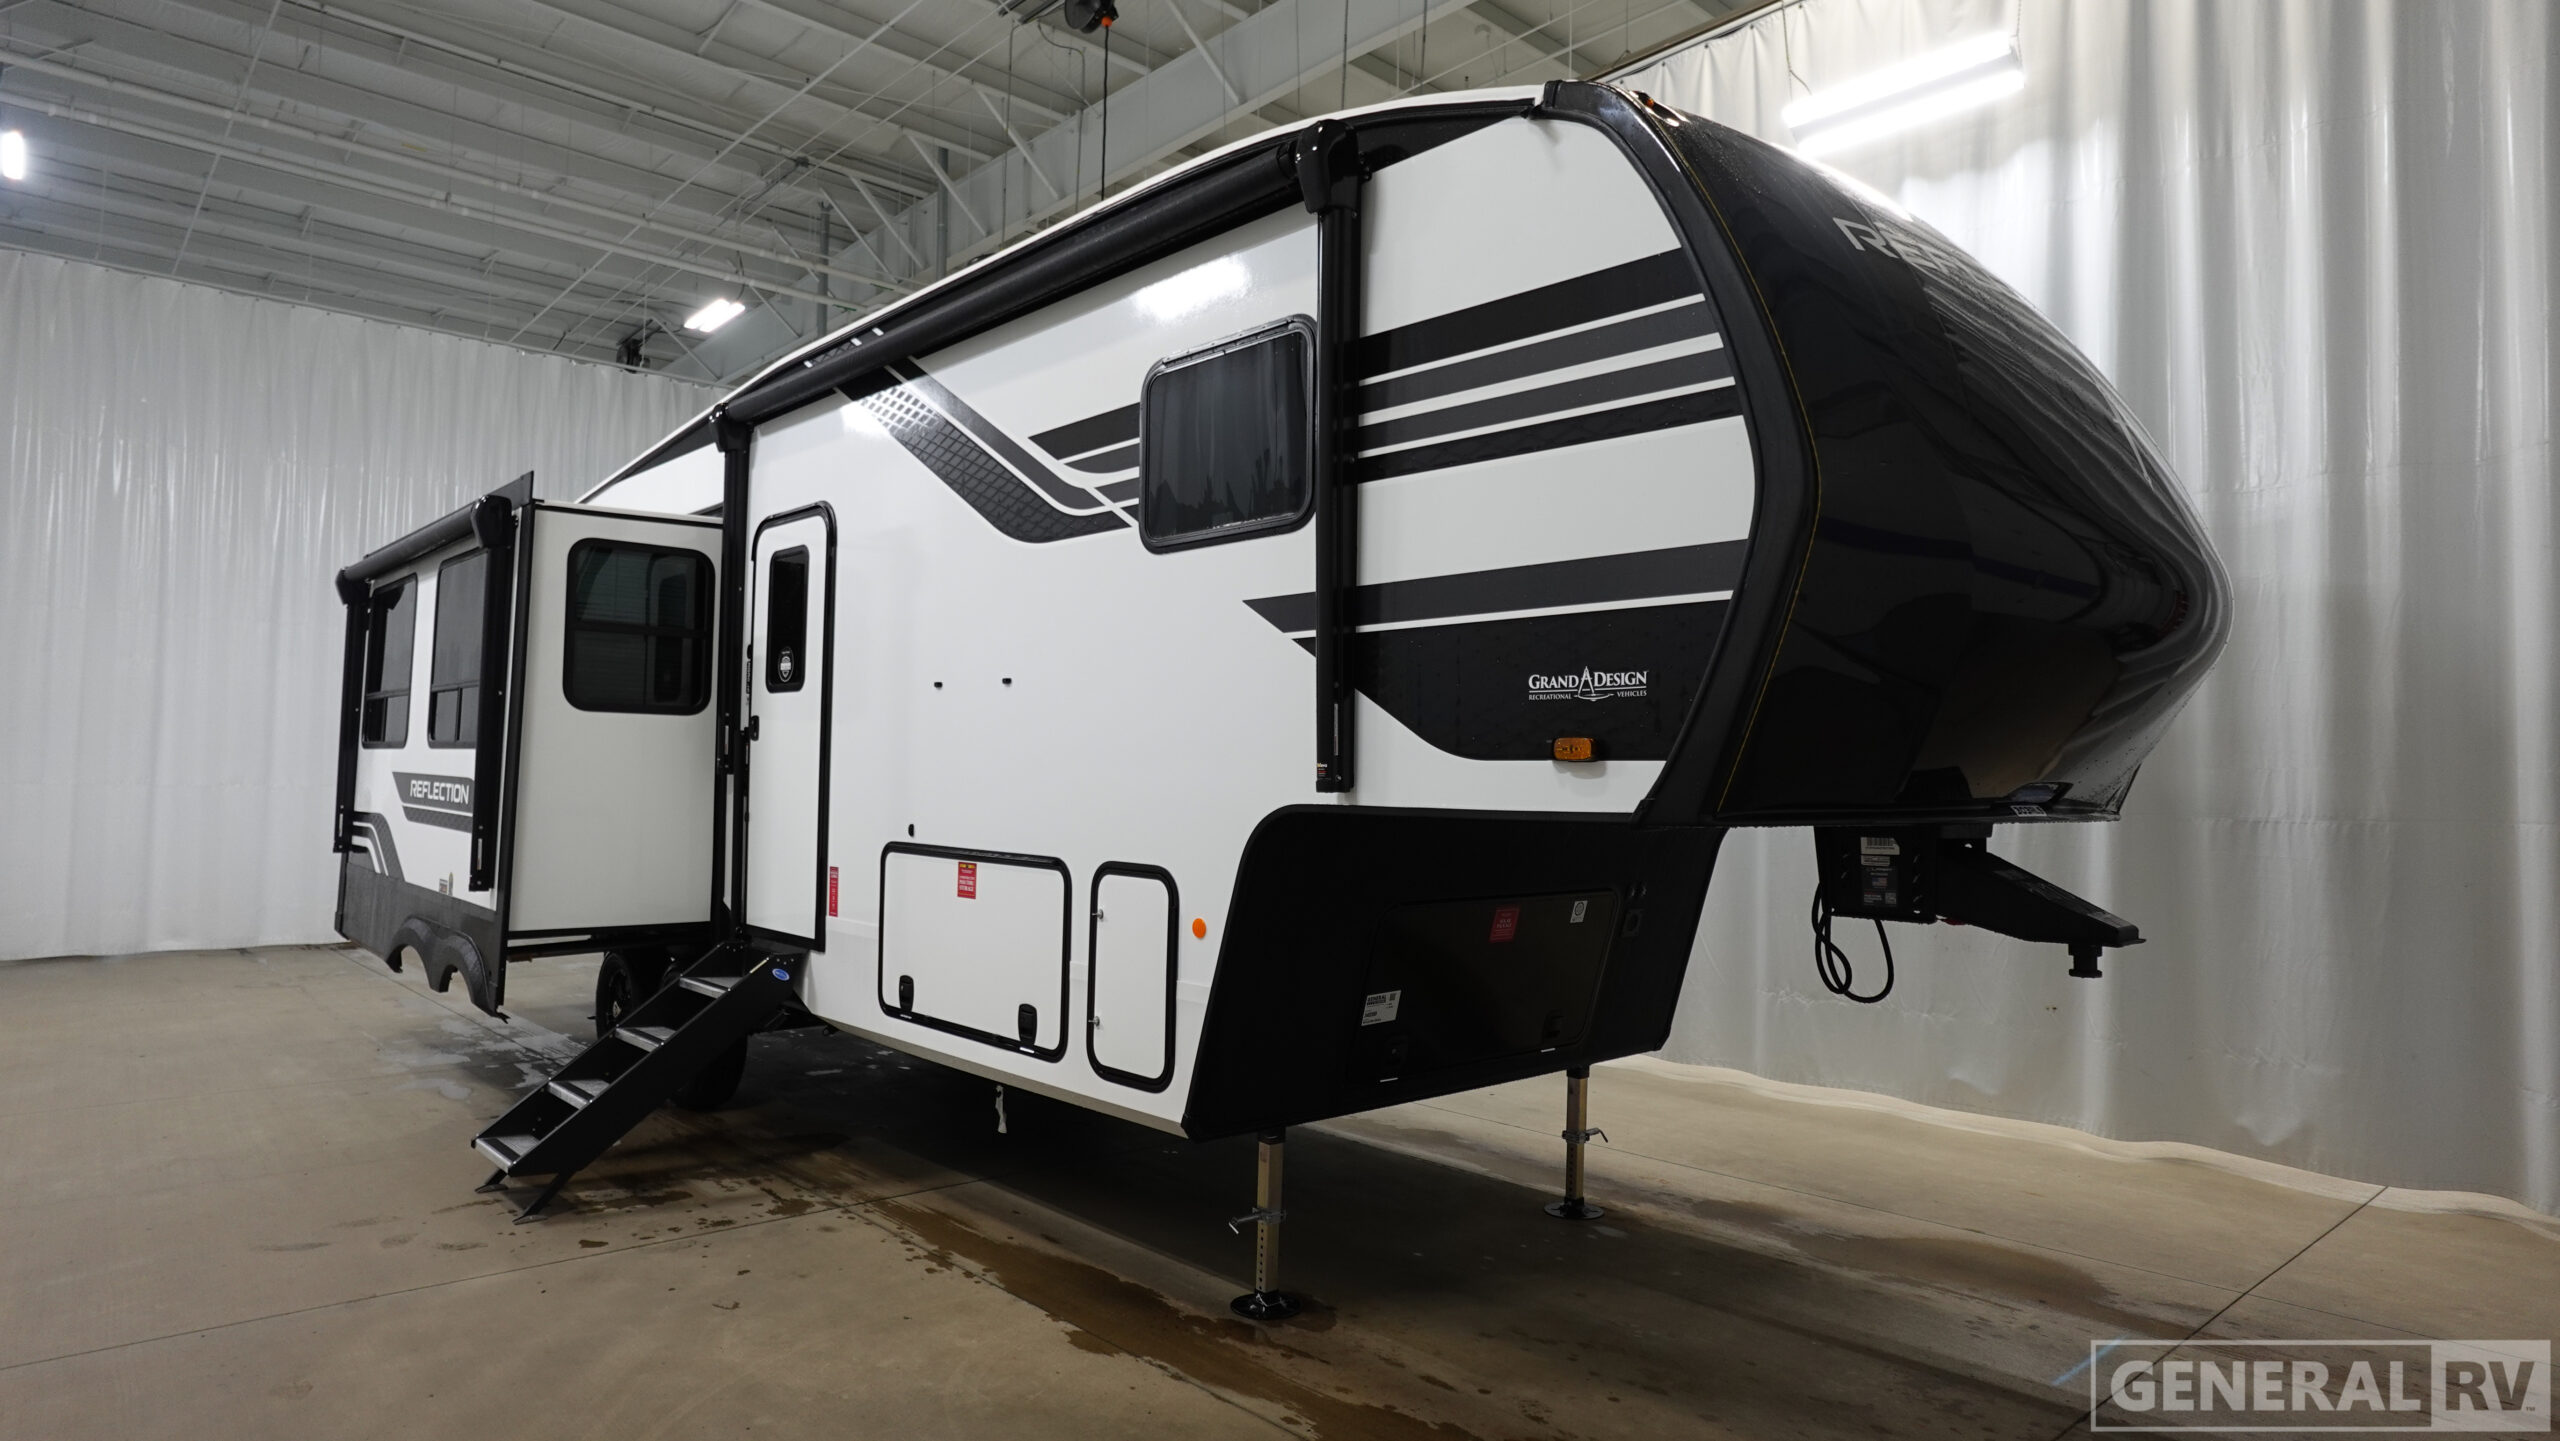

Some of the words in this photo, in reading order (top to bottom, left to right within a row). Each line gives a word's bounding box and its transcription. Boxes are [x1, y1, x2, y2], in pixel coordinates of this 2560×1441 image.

[1528, 674, 1579, 690] GRAND
[1594, 671, 1648, 687] DESIGN
[1528, 693, 1572, 701] RECREATIONAL
[1617, 689, 1648, 698] VEHICLES
[410, 780, 470, 805] REFLECTION
